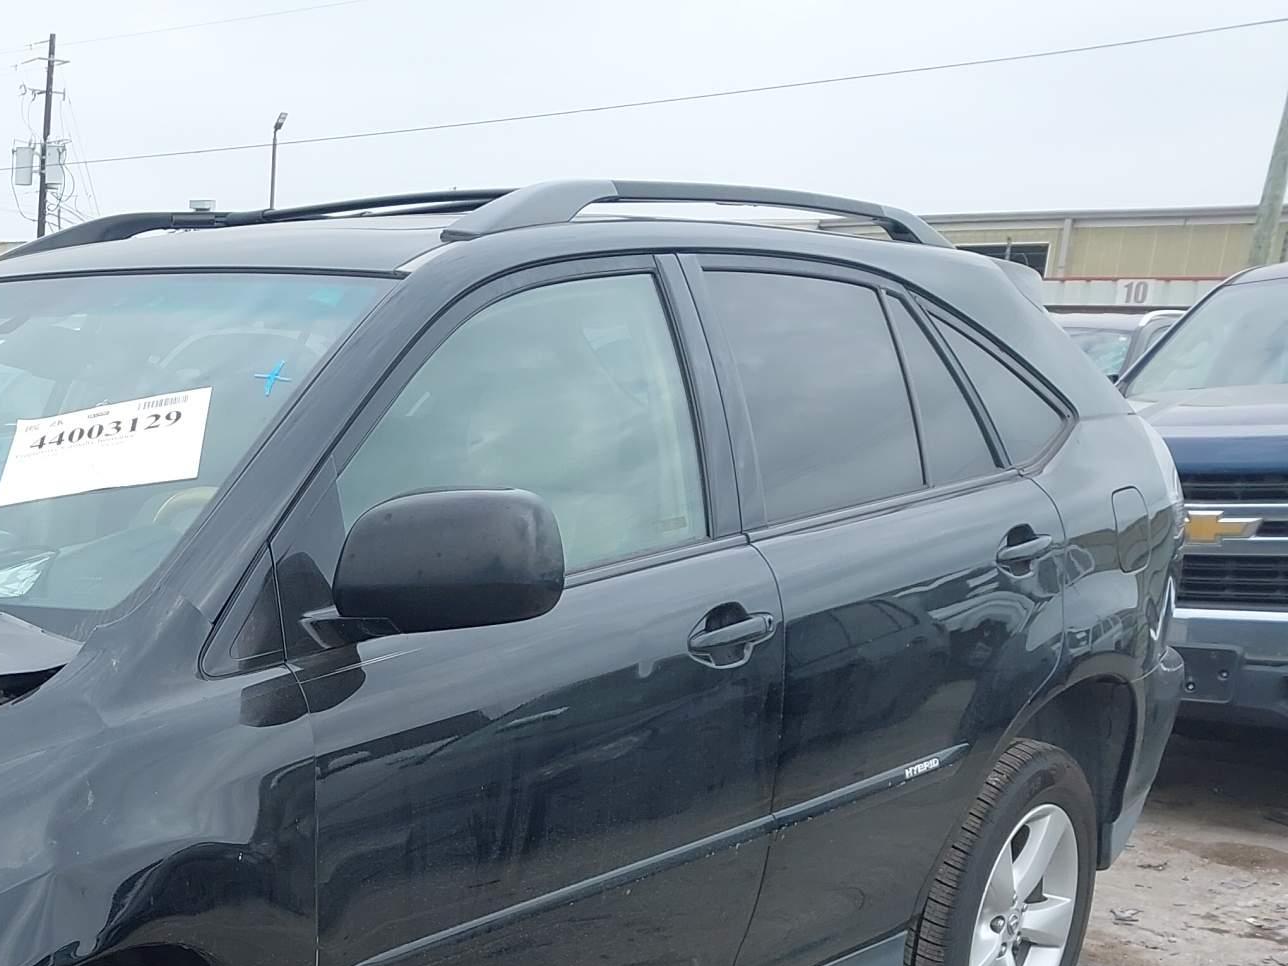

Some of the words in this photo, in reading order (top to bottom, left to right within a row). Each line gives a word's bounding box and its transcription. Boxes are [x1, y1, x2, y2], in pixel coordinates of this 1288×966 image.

[1124, 282, 1148, 304] 10
[30, 410, 182, 449] 44003129
[905, 758, 939, 778] HYBRID
